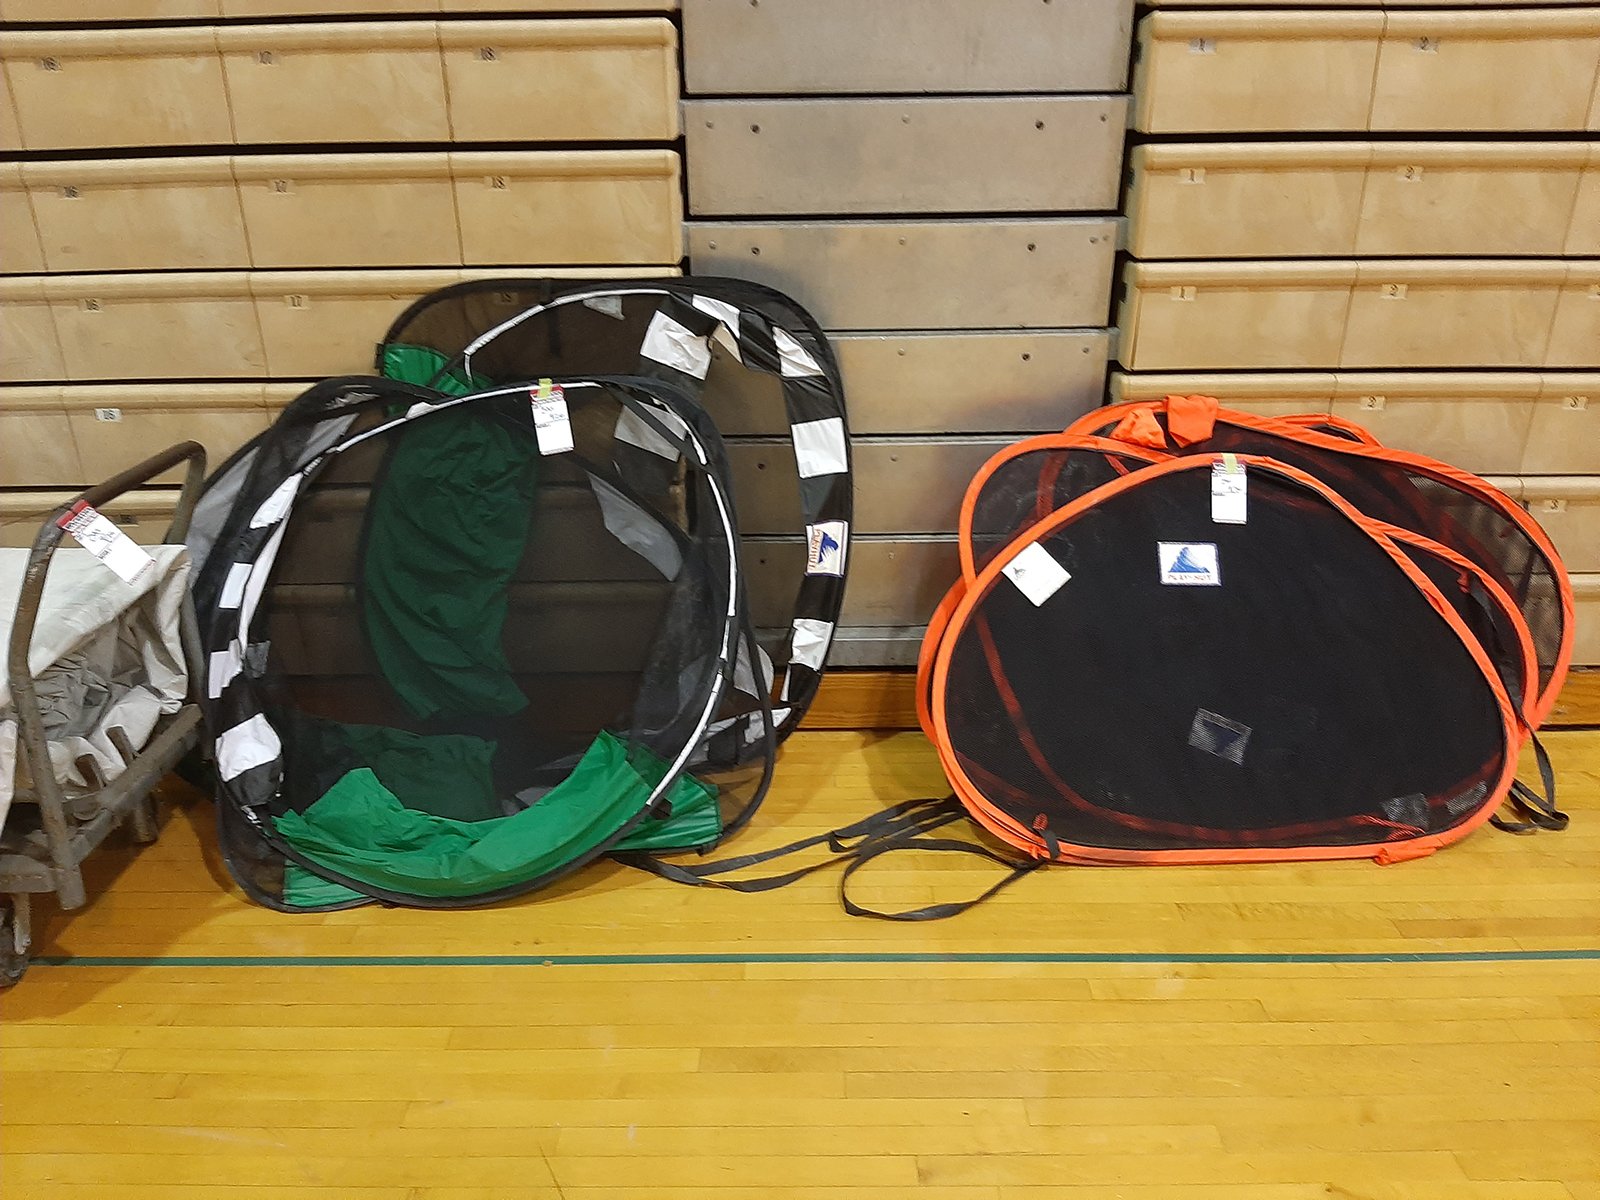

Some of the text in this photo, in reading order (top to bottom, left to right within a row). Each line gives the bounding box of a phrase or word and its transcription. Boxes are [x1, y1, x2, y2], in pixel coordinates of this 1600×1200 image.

[1406, 166, 1414, 180] 2
[1390, 284, 1398, 297] 2
[290, 296, 302, 308] 17
[1368, 396, 1376, 408] 2
[1570, 396, 1578, 409] 3
[1551, 499, 1559, 510] 3
